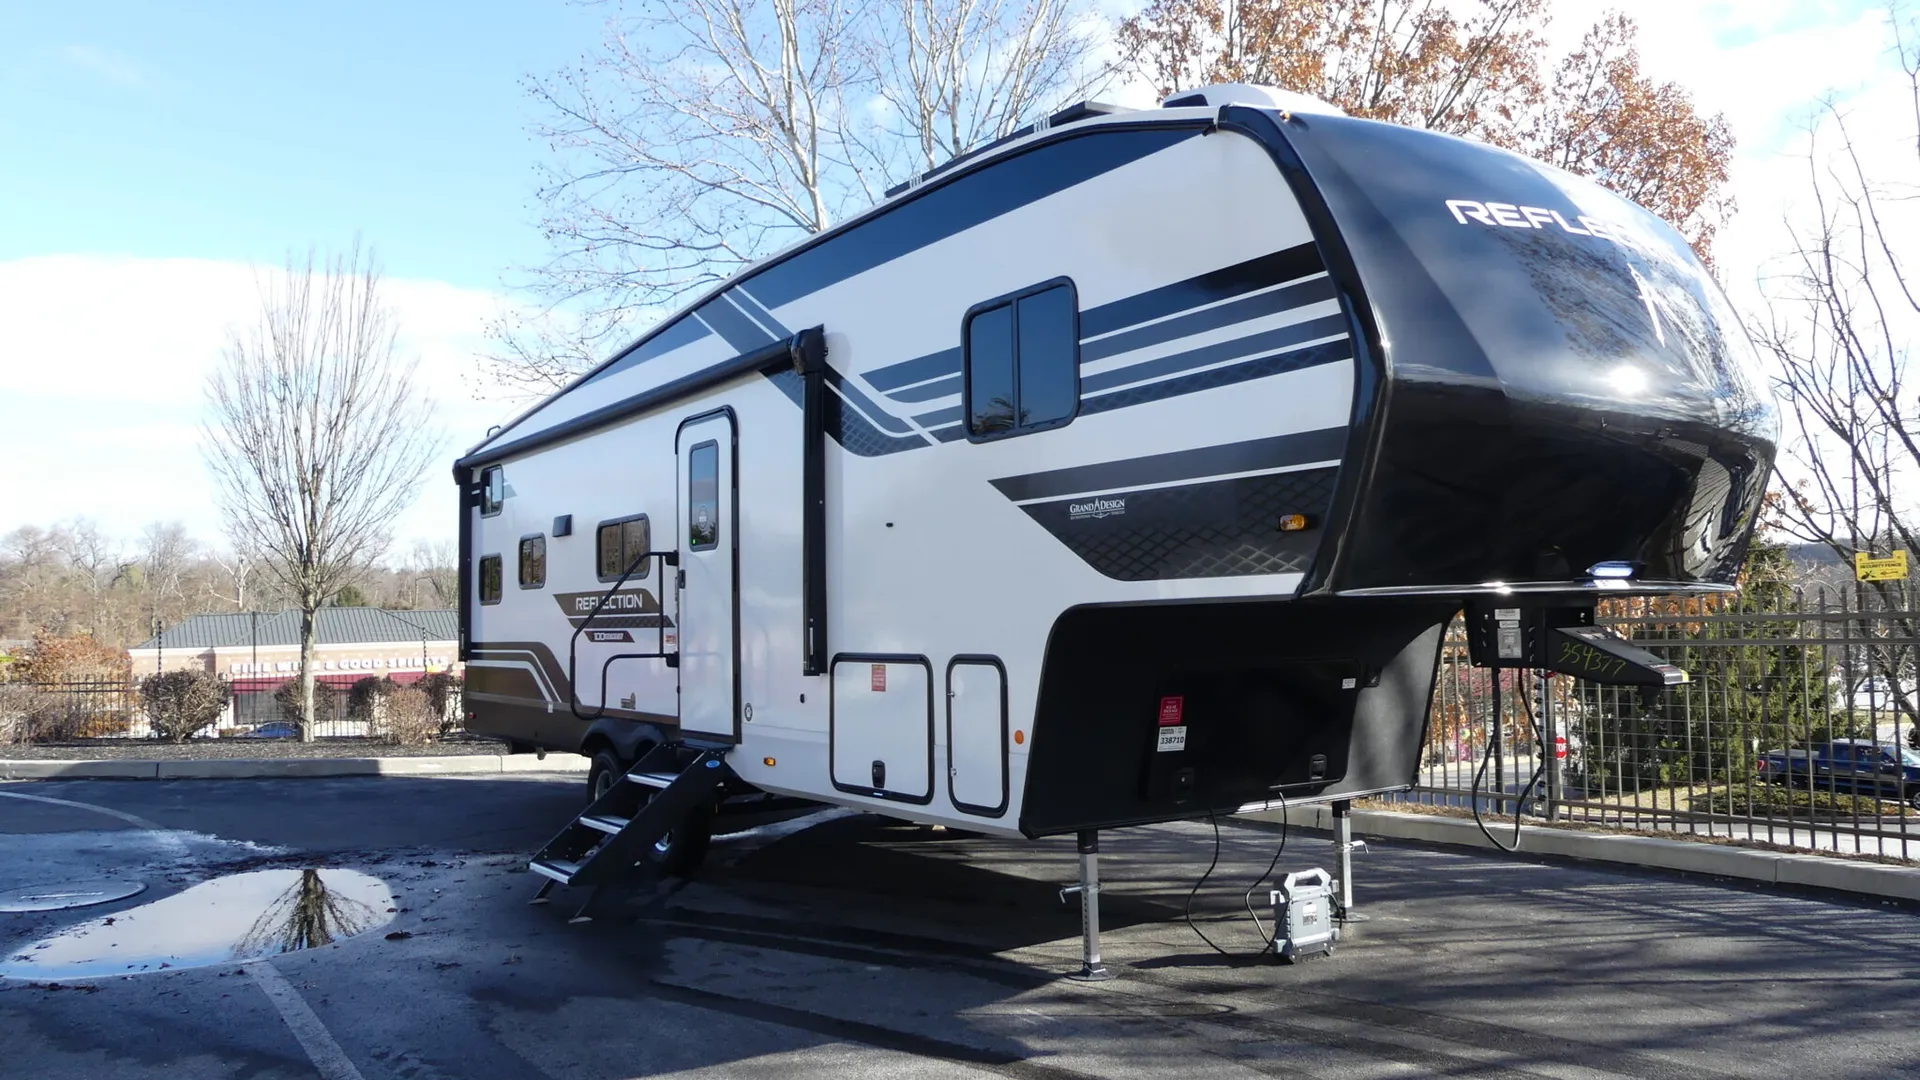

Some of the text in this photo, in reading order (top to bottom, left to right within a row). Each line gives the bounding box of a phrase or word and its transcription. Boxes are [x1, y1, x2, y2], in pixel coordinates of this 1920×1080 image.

[1070, 499, 1125, 513] GRAND DESIGN
[276, 660, 321, 672] WIE
[338, 657, 384, 670] GOOD
[1160, 736, 1185, 745] 338710
